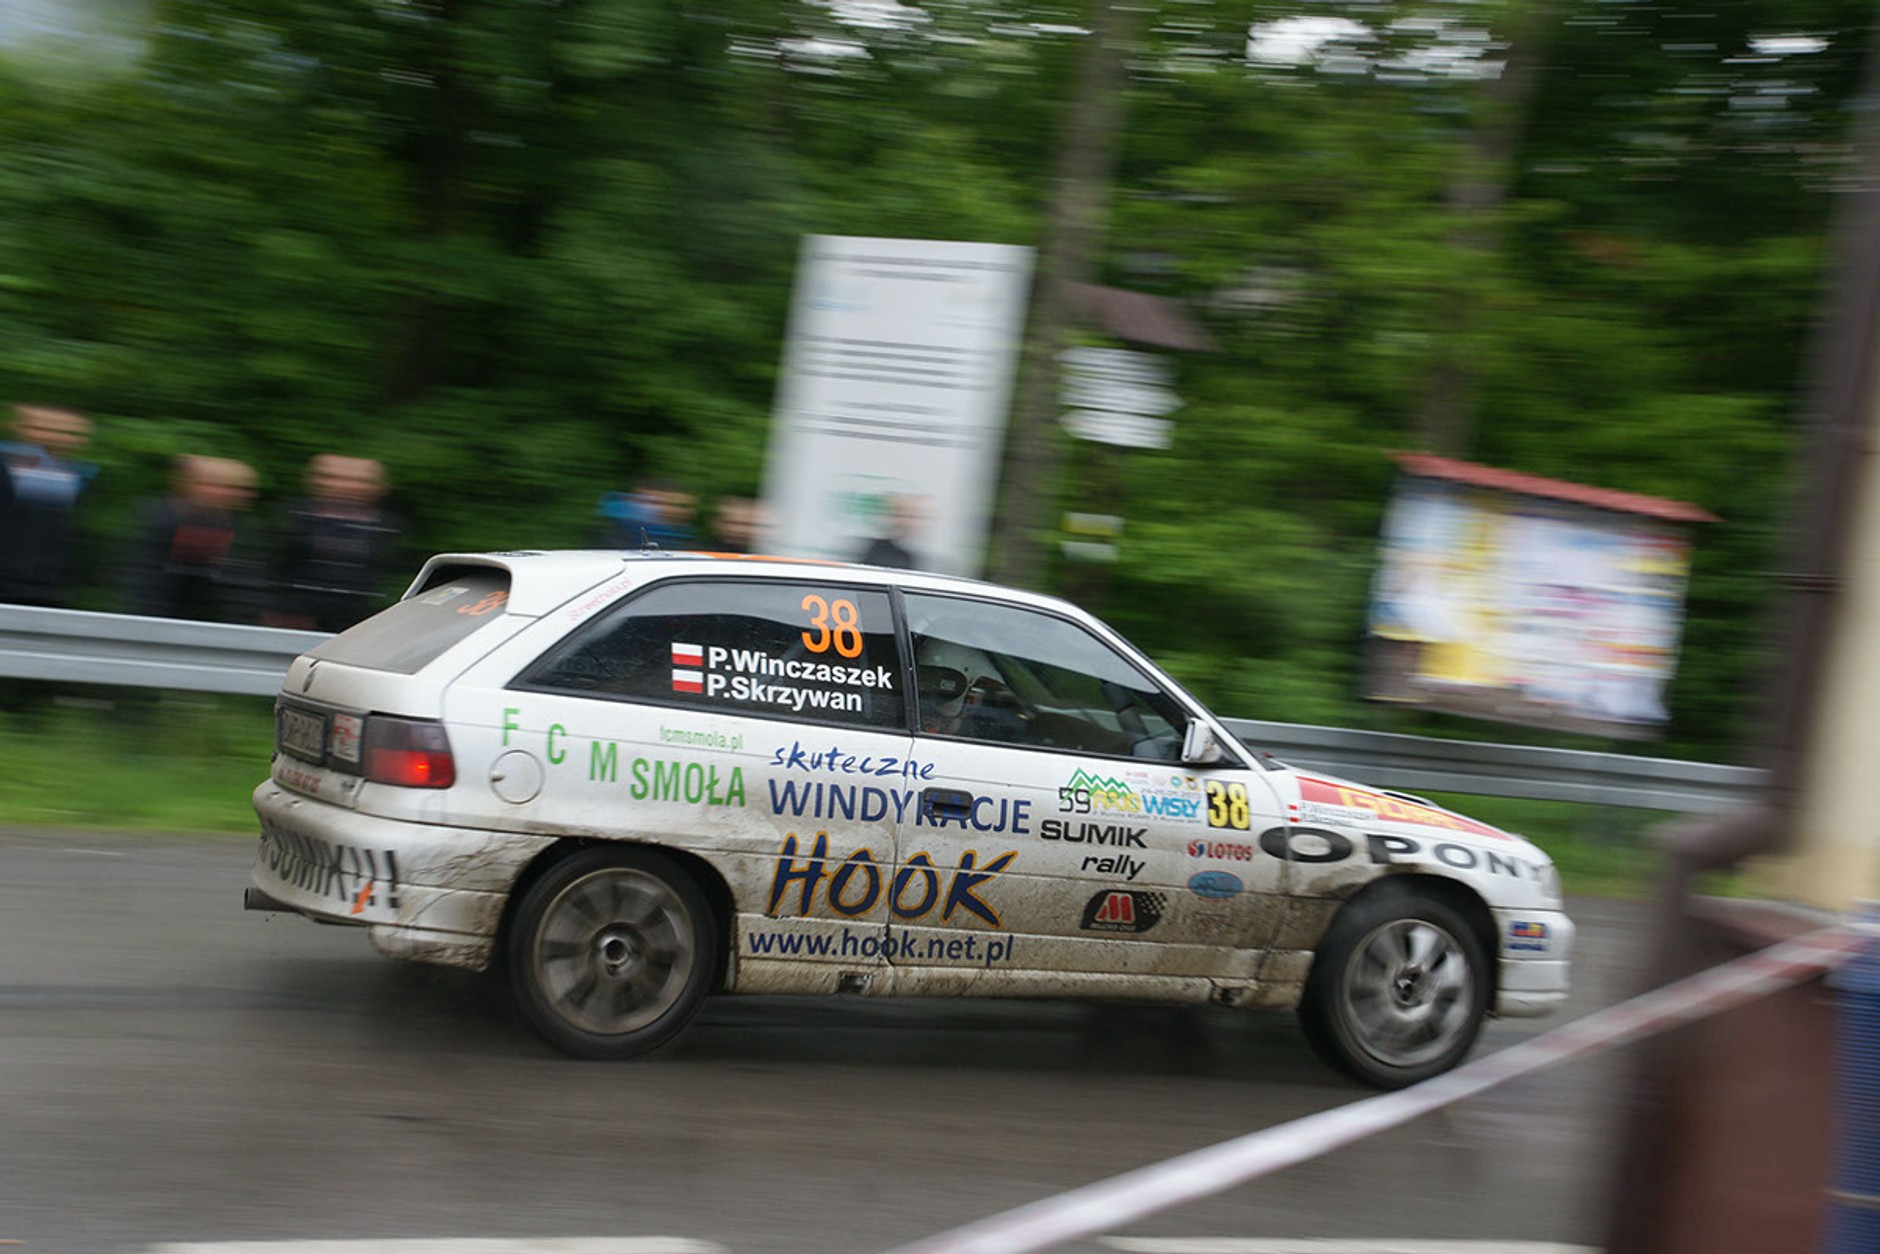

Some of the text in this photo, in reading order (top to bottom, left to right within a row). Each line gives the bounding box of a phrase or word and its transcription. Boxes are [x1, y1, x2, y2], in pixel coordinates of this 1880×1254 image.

[801, 593, 863, 659] 38
[707, 645, 893, 690] P.Winczaszek
[707, 673, 862, 712] P.Skrzywan
[630, 757, 746, 807] SMOŁA
[769, 741, 936, 781] skuteczne
[768, 778, 1032, 835] WINDYKACJE
[1058, 786, 1092, 814] 59
[1206, 780, 1250, 830] 38
[1040, 818, 1148, 849] SUMIK
[1206, 842, 1253, 862] LOTOS
[1260, 825, 1542, 881] OPONY
[766, 830, 1019, 930] HOOK
[1081, 854, 1147, 881] rally
[748, 927, 1015, 968] www.hook.net.pl
